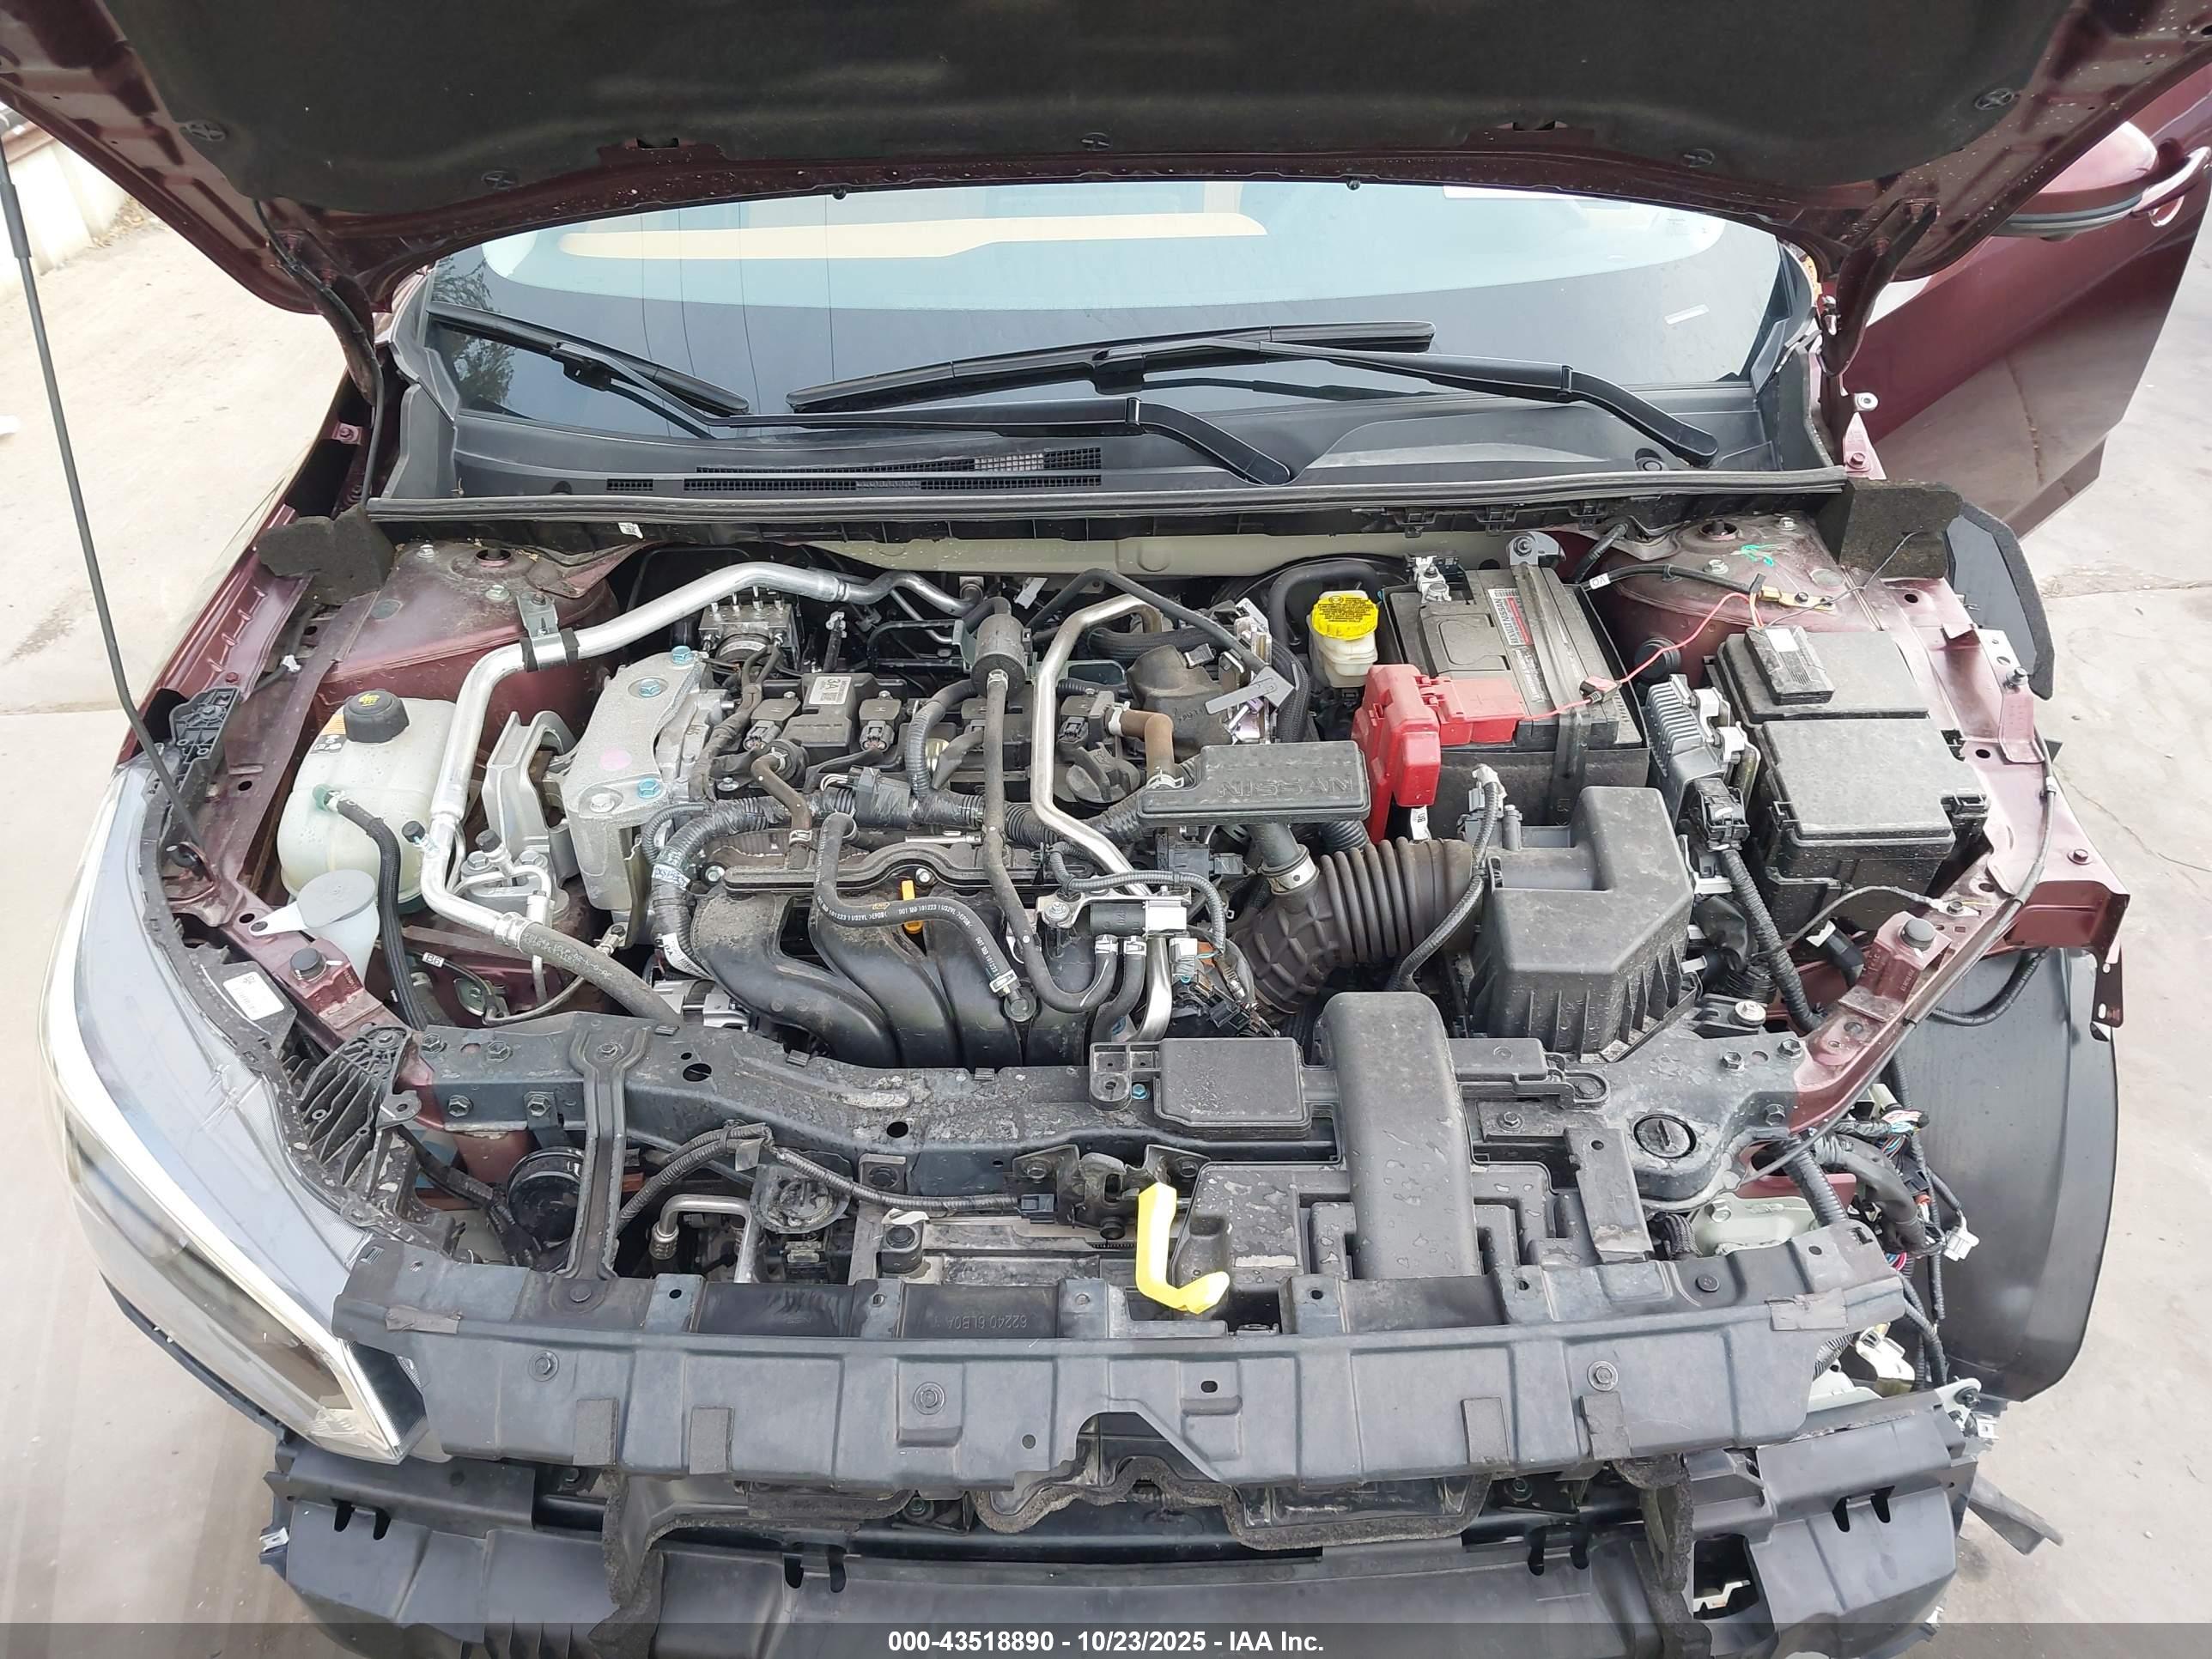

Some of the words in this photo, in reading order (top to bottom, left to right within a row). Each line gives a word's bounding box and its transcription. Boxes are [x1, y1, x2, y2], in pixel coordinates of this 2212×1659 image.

[1218, 777, 1354, 798] NISSAN
[426, 954, 441, 965] B6
[989, 1315, 1028, 1329] 62240
